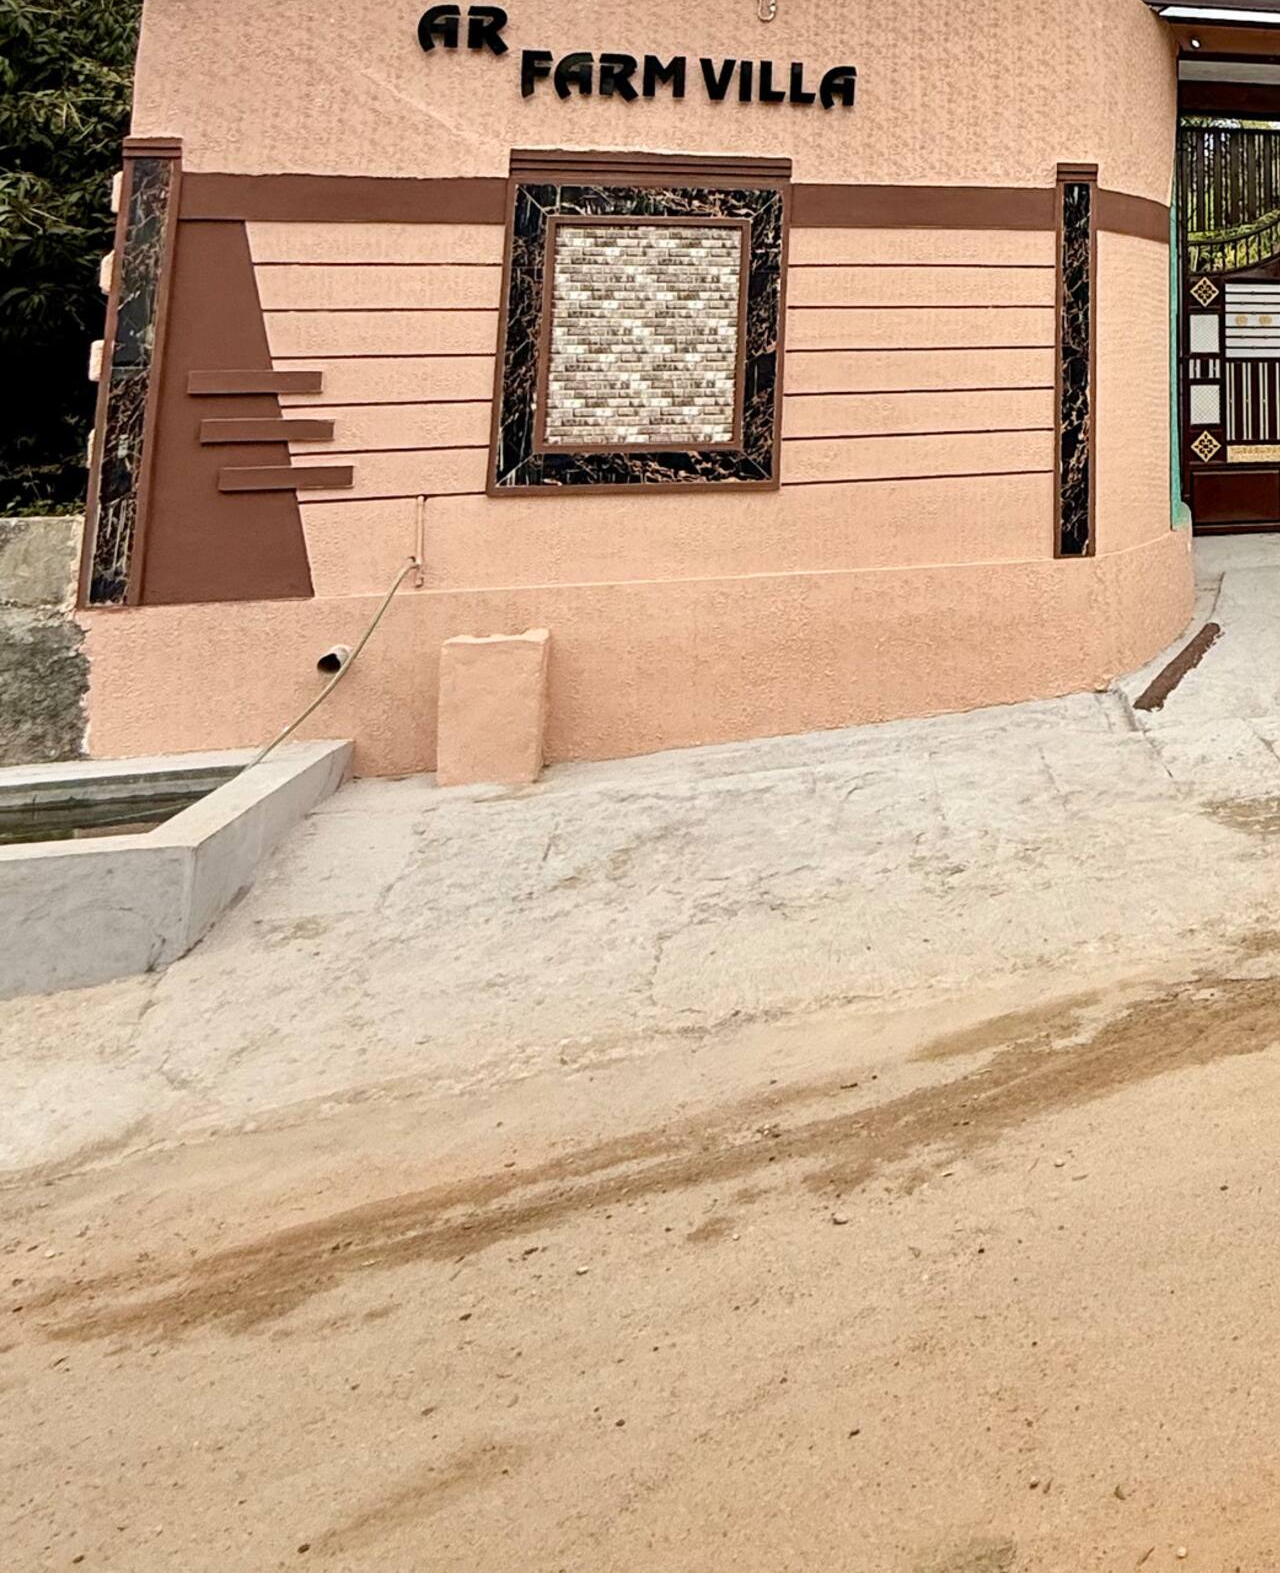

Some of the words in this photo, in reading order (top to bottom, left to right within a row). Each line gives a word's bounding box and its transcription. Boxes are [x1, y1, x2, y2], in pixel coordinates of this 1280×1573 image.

[418, 5, 508, 55] AR
[521, 50, 687, 102] FARM
[700, 58, 857, 109] VILLA
